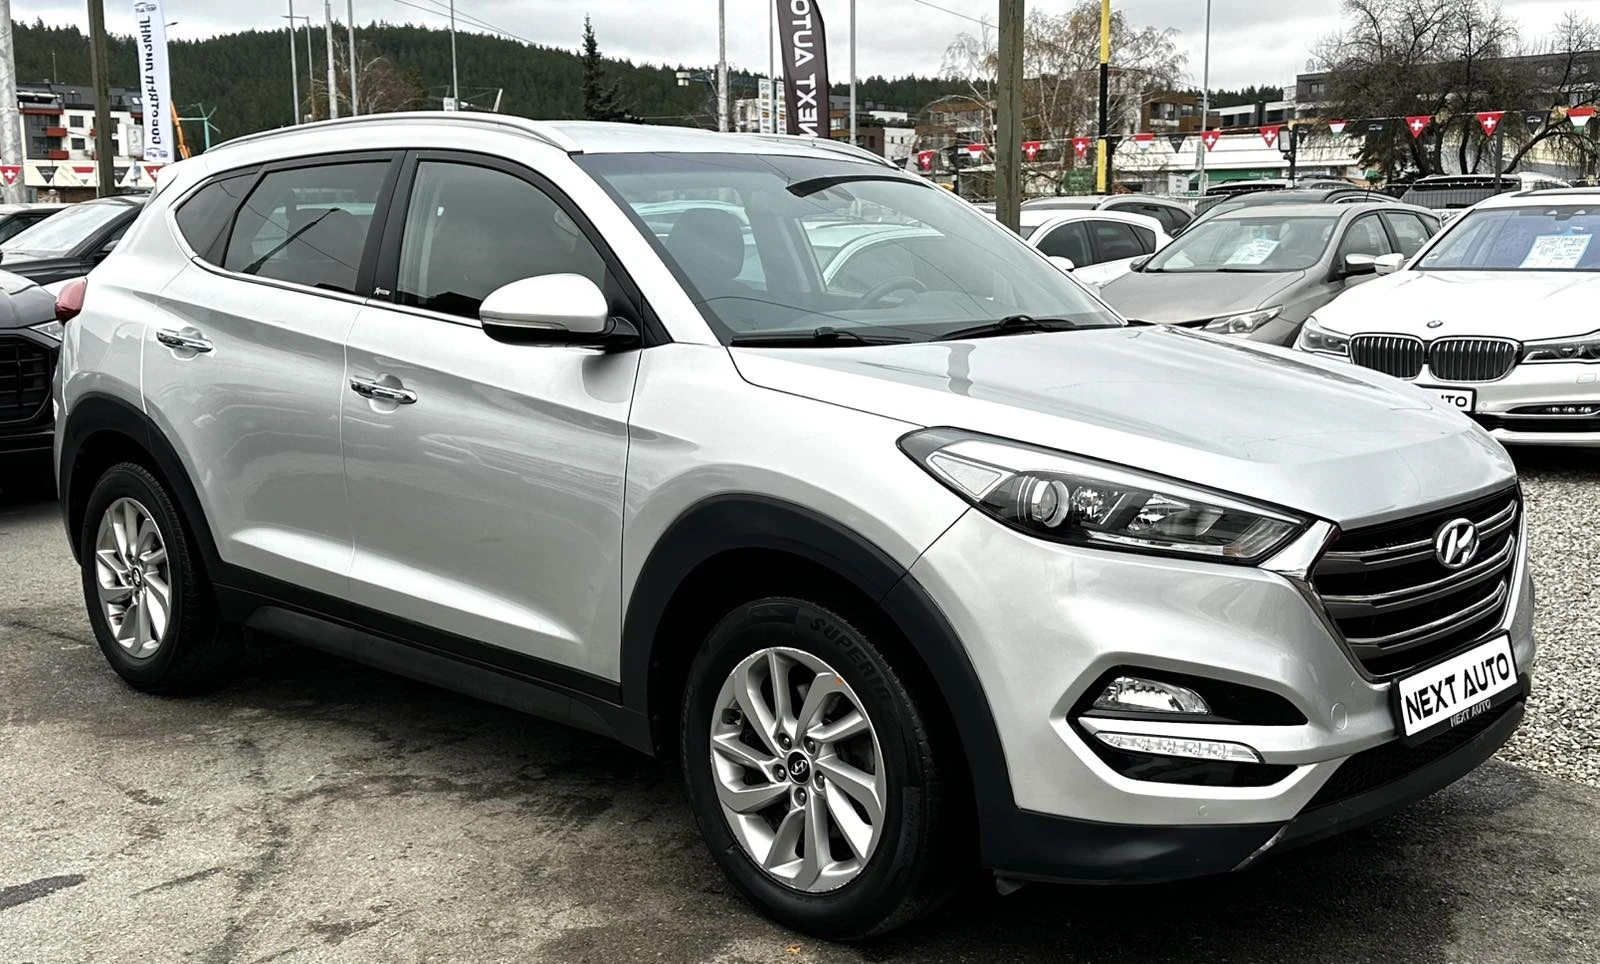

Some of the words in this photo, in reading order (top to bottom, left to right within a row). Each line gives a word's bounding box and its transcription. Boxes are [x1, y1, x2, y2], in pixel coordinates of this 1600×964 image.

[1406, 674, 1456, 725] NEXT
[1464, 653, 1509, 700] AUTO
[1450, 708, 1470, 728] NEXT
[1471, 699, 1491, 718] AUTO
